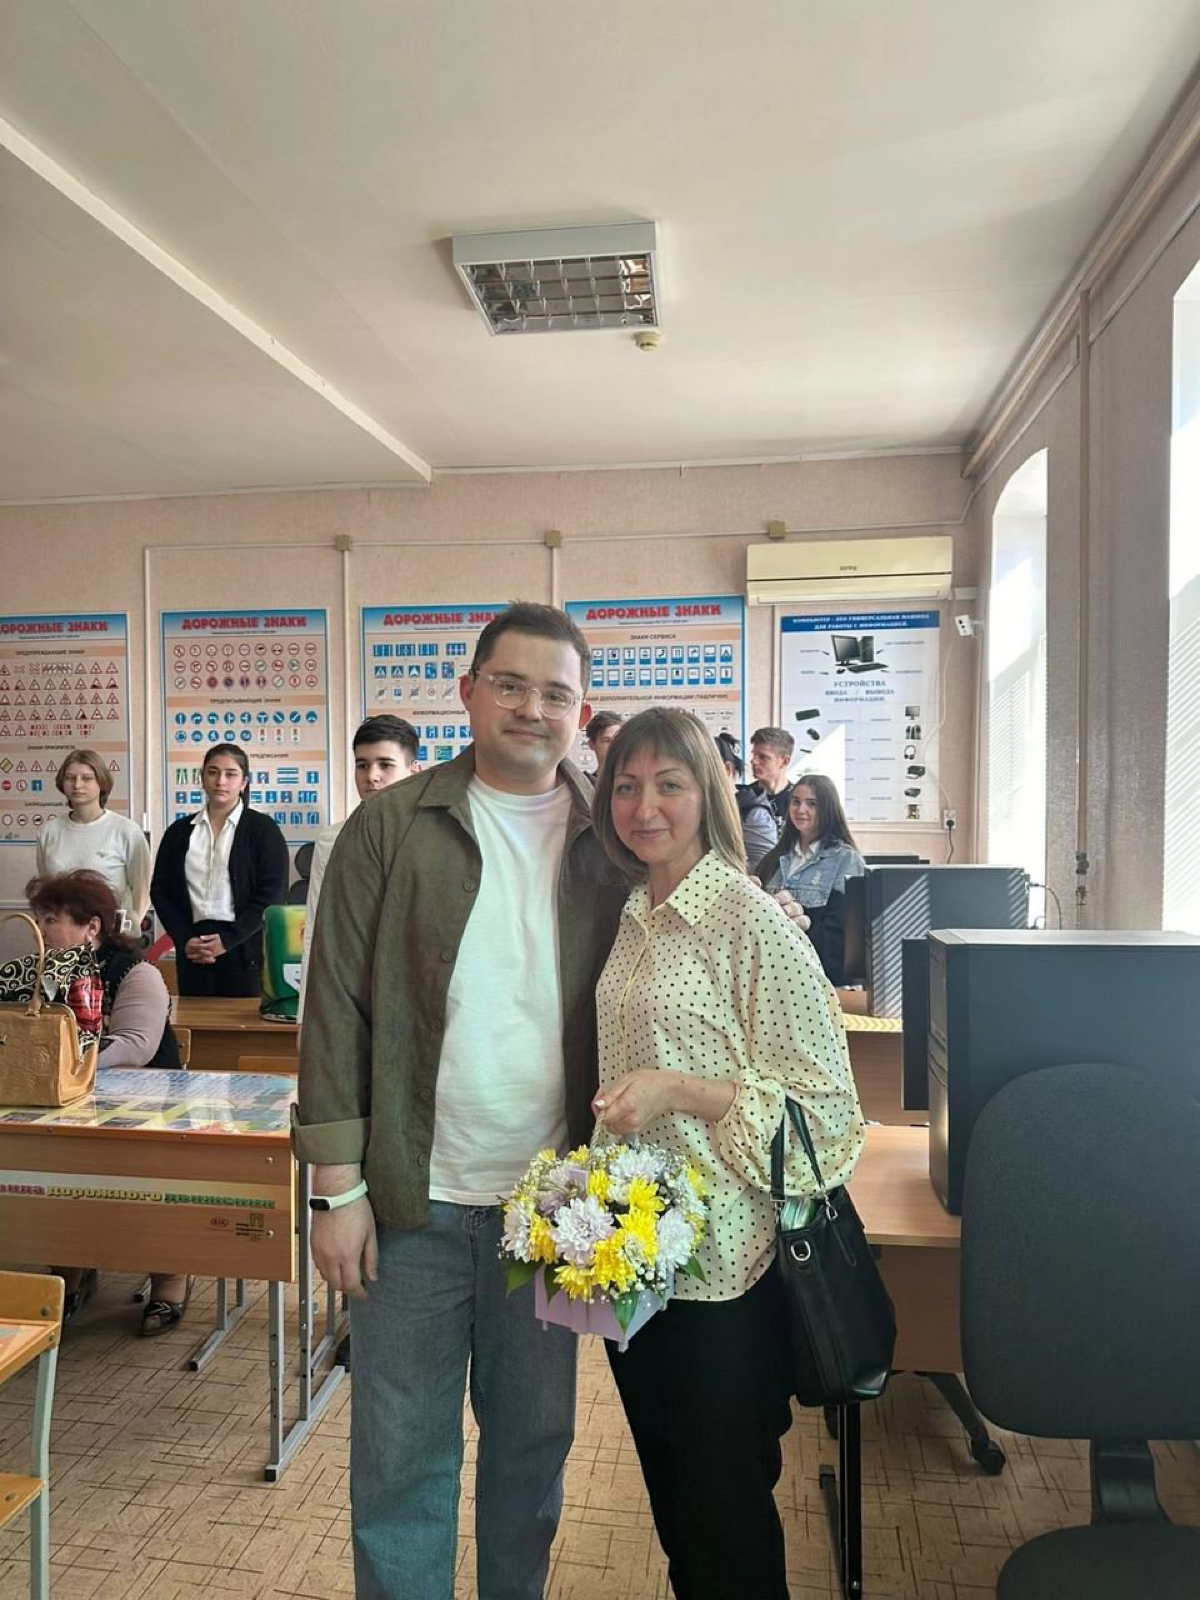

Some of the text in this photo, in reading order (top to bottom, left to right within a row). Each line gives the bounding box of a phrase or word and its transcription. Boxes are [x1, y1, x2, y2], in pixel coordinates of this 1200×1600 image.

[384, 611, 496, 625] ДОРОЖНЫЕ ЗНА
[586, 604, 721, 620] ДОРОЖНЫЕ ЗНАКИ
[0, 620, 108, 635] ОРОЖНЫЕ ЗНАКИ
[182, 616, 307, 630] ДОРОЖНЫЕ ЗНАКИ
[834, 680, 886, 688] УСТРОЙСТВА
[47, 1186, 162, 1202] дорожного
